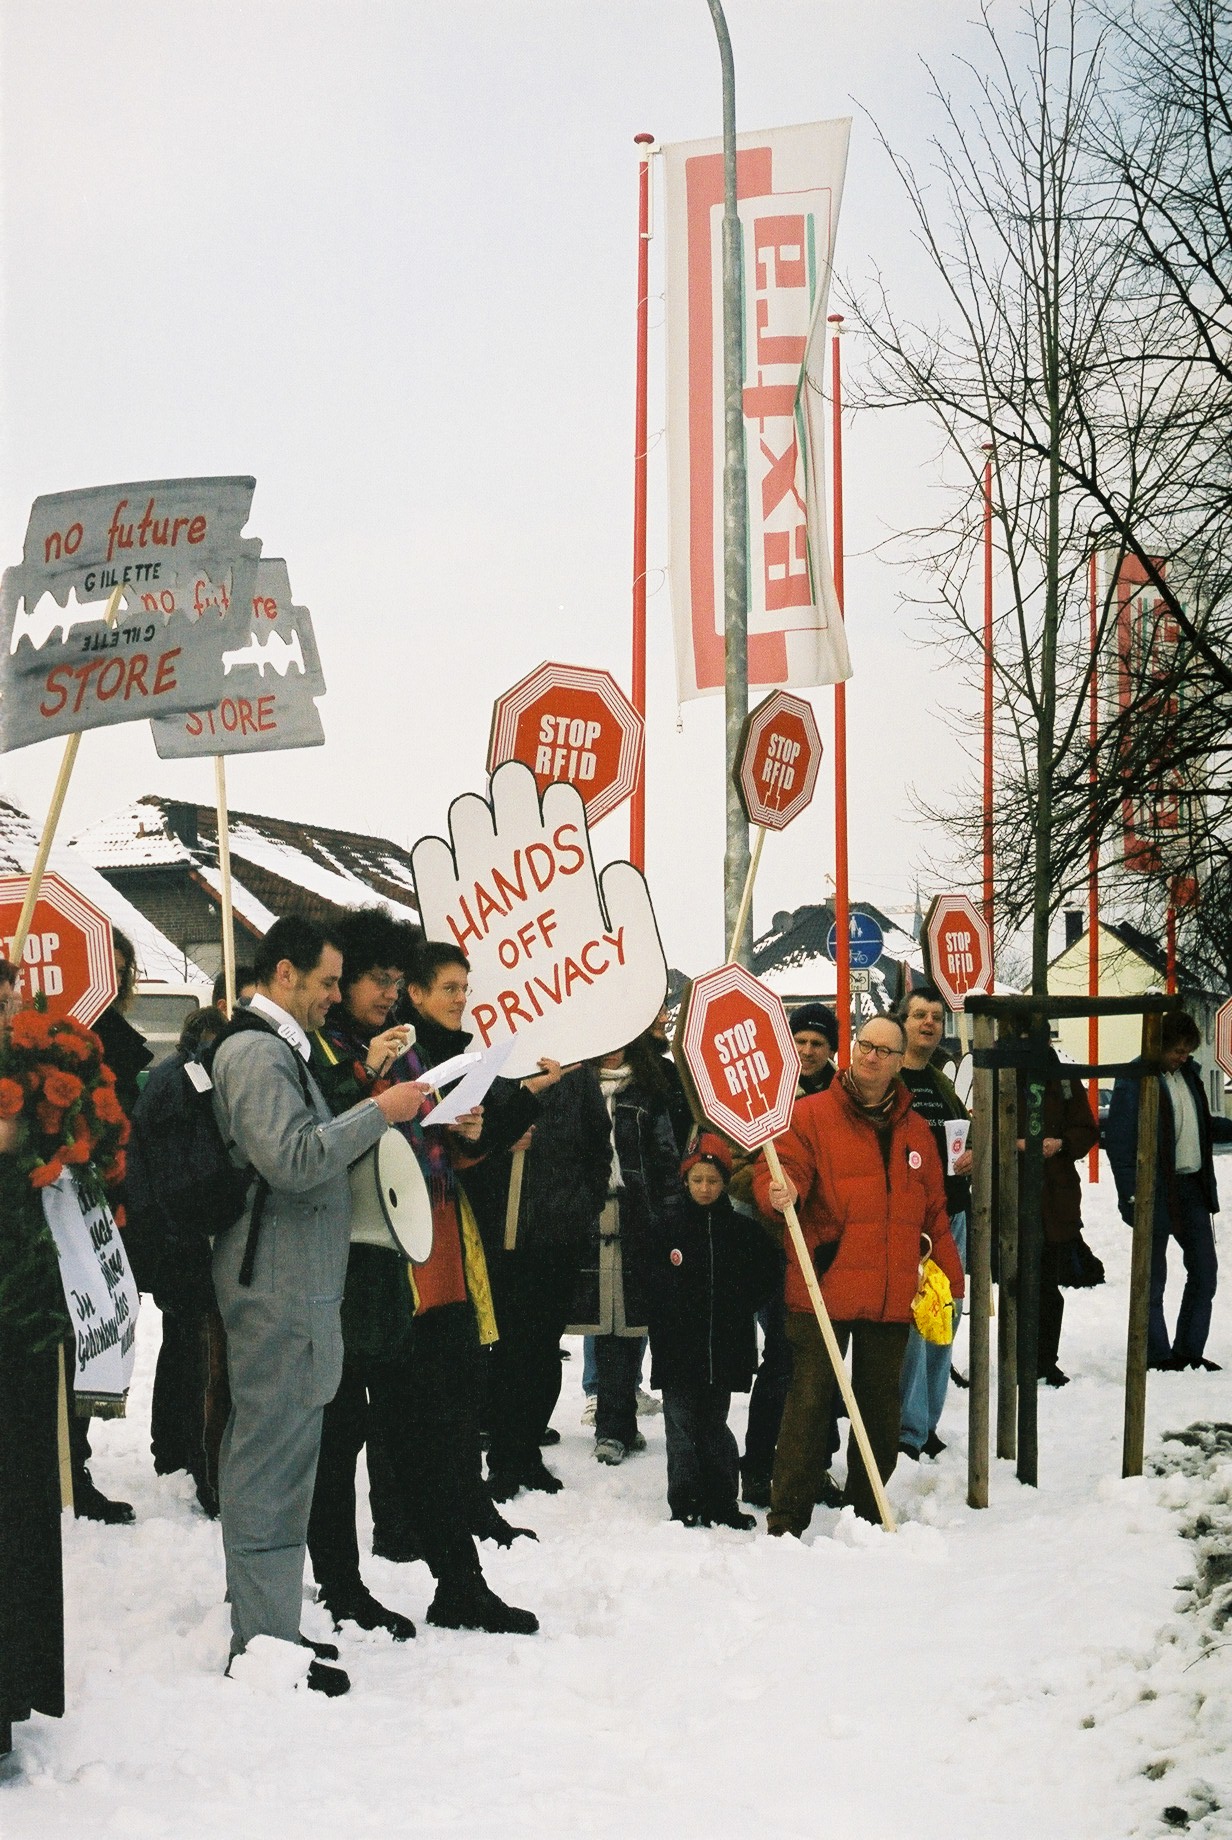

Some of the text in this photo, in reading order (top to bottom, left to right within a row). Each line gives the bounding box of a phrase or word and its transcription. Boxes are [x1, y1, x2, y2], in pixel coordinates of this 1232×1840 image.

[44, 497, 207, 564] no future
[84, 562, 162, 593] GILLETTE
[140, 589, 175, 614] no
[39, 647, 183, 718] STORE
[539, 714, 602, 749] STOP
[767, 732, 801, 765] STOP
[534, 745, 597, 781] RFID
[761, 757, 796, 790] RFID
[446, 823, 585, 957] HANDS
[499, 908, 558, 969] OFF
[945, 931, 971, 952] STOP
[947, 953, 974, 974] RFID
[13, 965, 64, 998] FID
[471, 926, 626, 1049] PRIVACY
[713, 1018, 758, 1065] STOP
[723, 1050, 771, 1096] RFID
